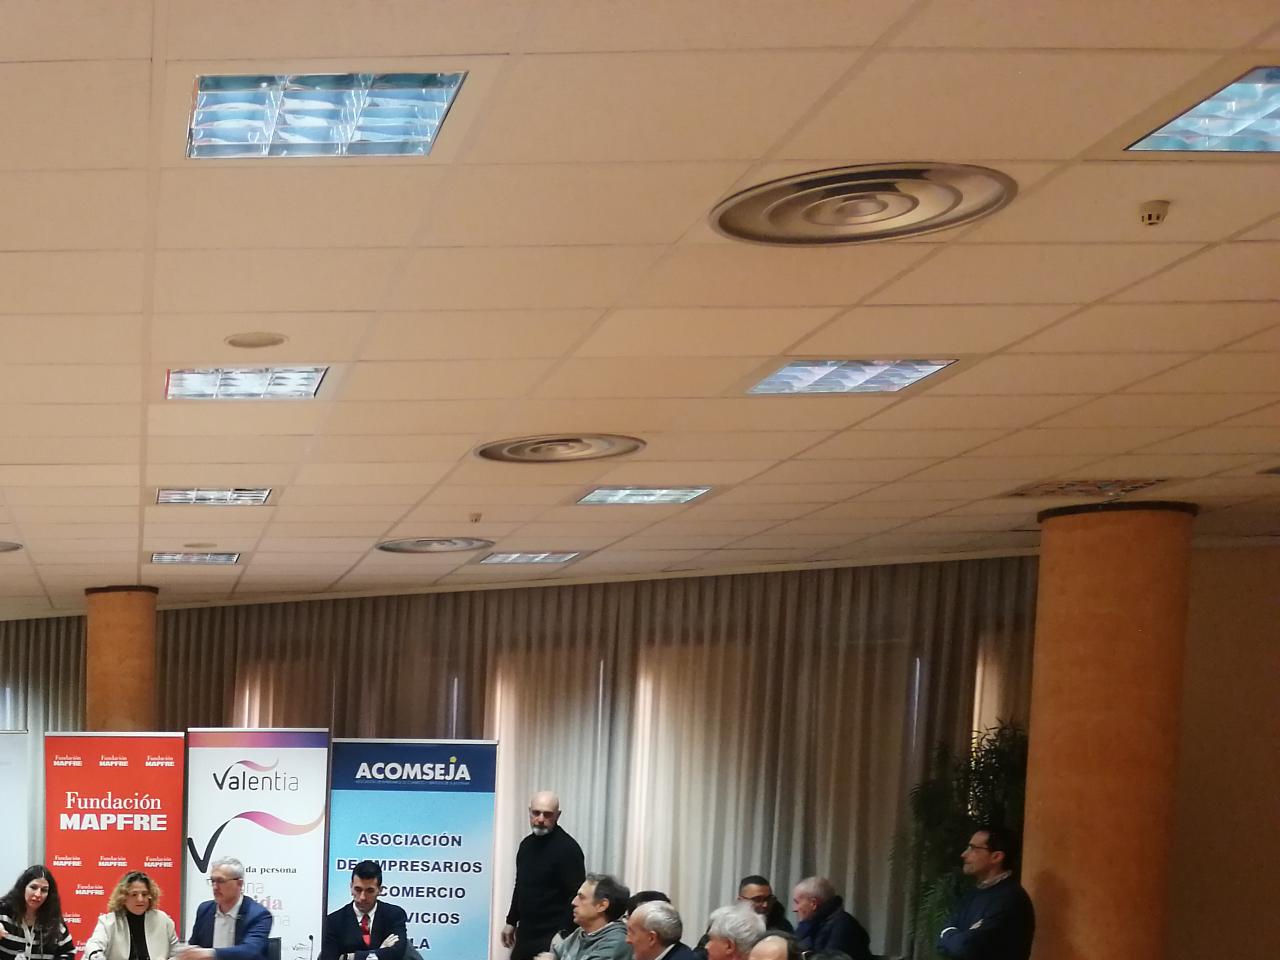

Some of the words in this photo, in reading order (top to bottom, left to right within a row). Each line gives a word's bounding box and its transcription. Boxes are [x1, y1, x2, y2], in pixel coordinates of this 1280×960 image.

[355, 756, 470, 781] ACOMSEJA
[212, 766, 299, 791] Valentia
[65, 791, 162, 809] Fundación
[60, 813, 167, 831] MAPFRE
[357, 833, 462, 847] ASOCIACIÓN
[260, 867, 297, 875] persona
[337, 859, 357, 870] DE
[376, 860, 482, 873] MPRESARIOS
[380, 886, 466, 899] COMERCIO
[406, 913, 460, 924] VICIOS
[412, 938, 430, 949] LA
